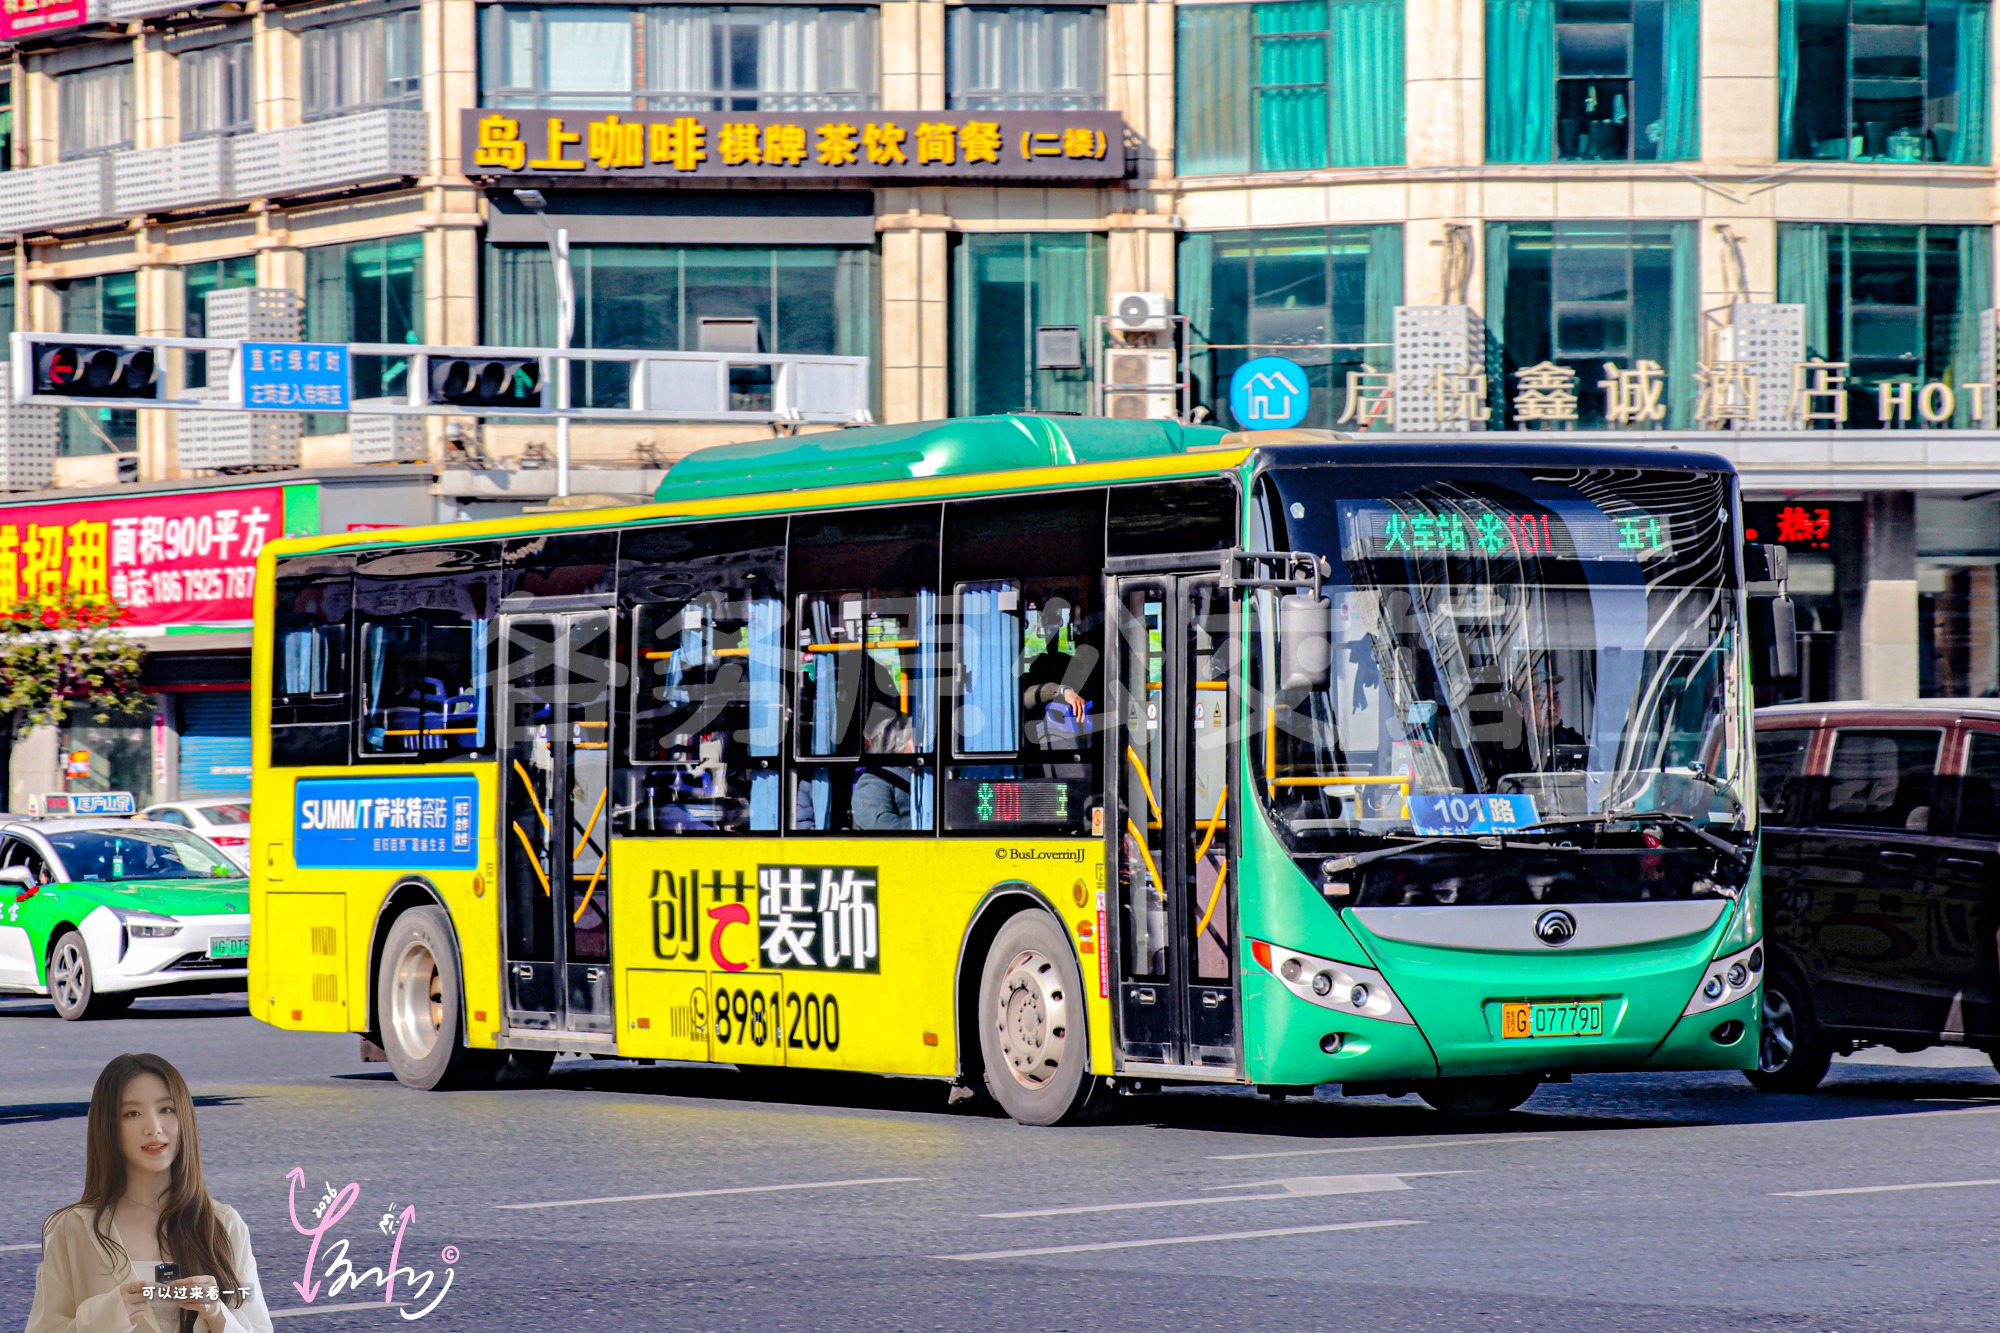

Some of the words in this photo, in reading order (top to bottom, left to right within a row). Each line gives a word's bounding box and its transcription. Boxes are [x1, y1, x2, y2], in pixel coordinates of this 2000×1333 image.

[474, 113, 707, 172] 岛上咖啡
[717, 120, 1002, 165] 棋牌茶饮简餐
[1336, 358, 1849, 425] 启悦鑫诚酒店
[1878, 381, 1993, 422] HOT
[111, 506, 270, 567] 面积900平方
[1384, 513, 1466, 551] 火车站
[1507, 513, 1555, 554] 101
[994, 782, 1020, 822] 101
[1433, 797, 1516, 824] 101路
[648, 868, 878, 972] 创艺装饰
[715, 987, 840, 1052] 8981200
